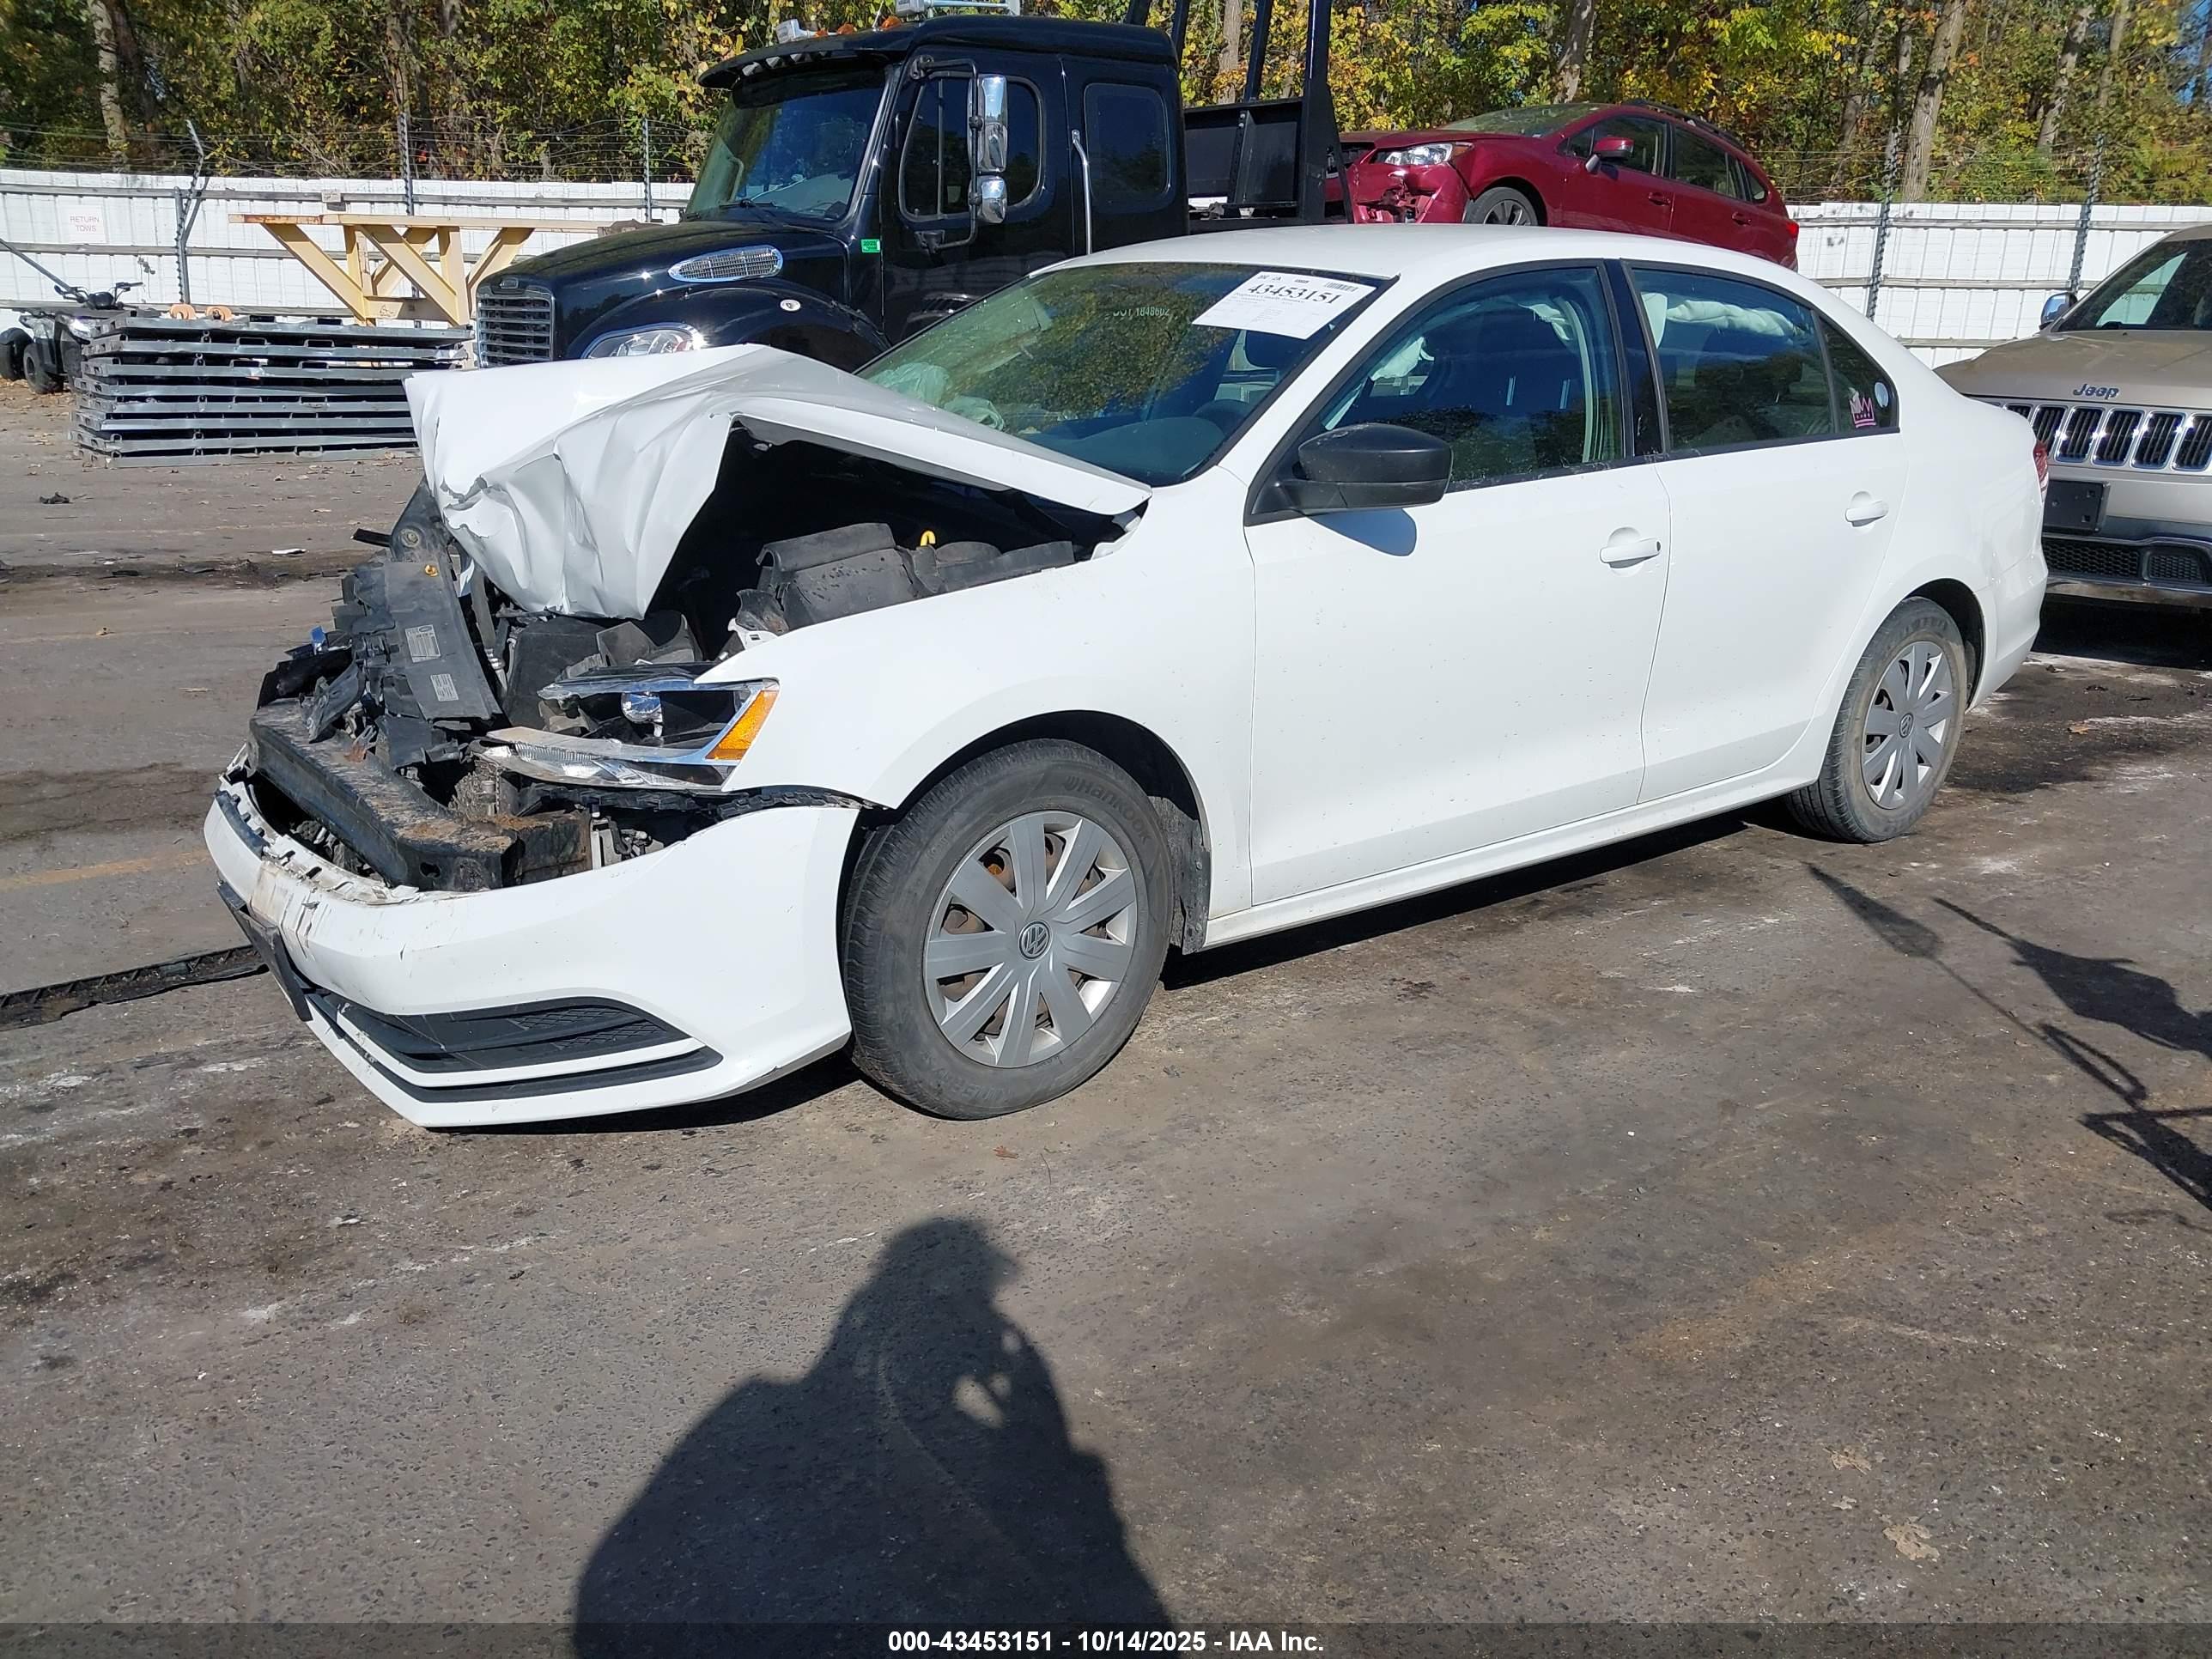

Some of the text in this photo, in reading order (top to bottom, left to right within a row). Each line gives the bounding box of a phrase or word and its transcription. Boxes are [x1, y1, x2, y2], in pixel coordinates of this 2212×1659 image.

[1248, 283, 1342, 304] 43453151
[2073, 383, 2119, 400] Jeep
[1020, 922, 1049, 959] VW
